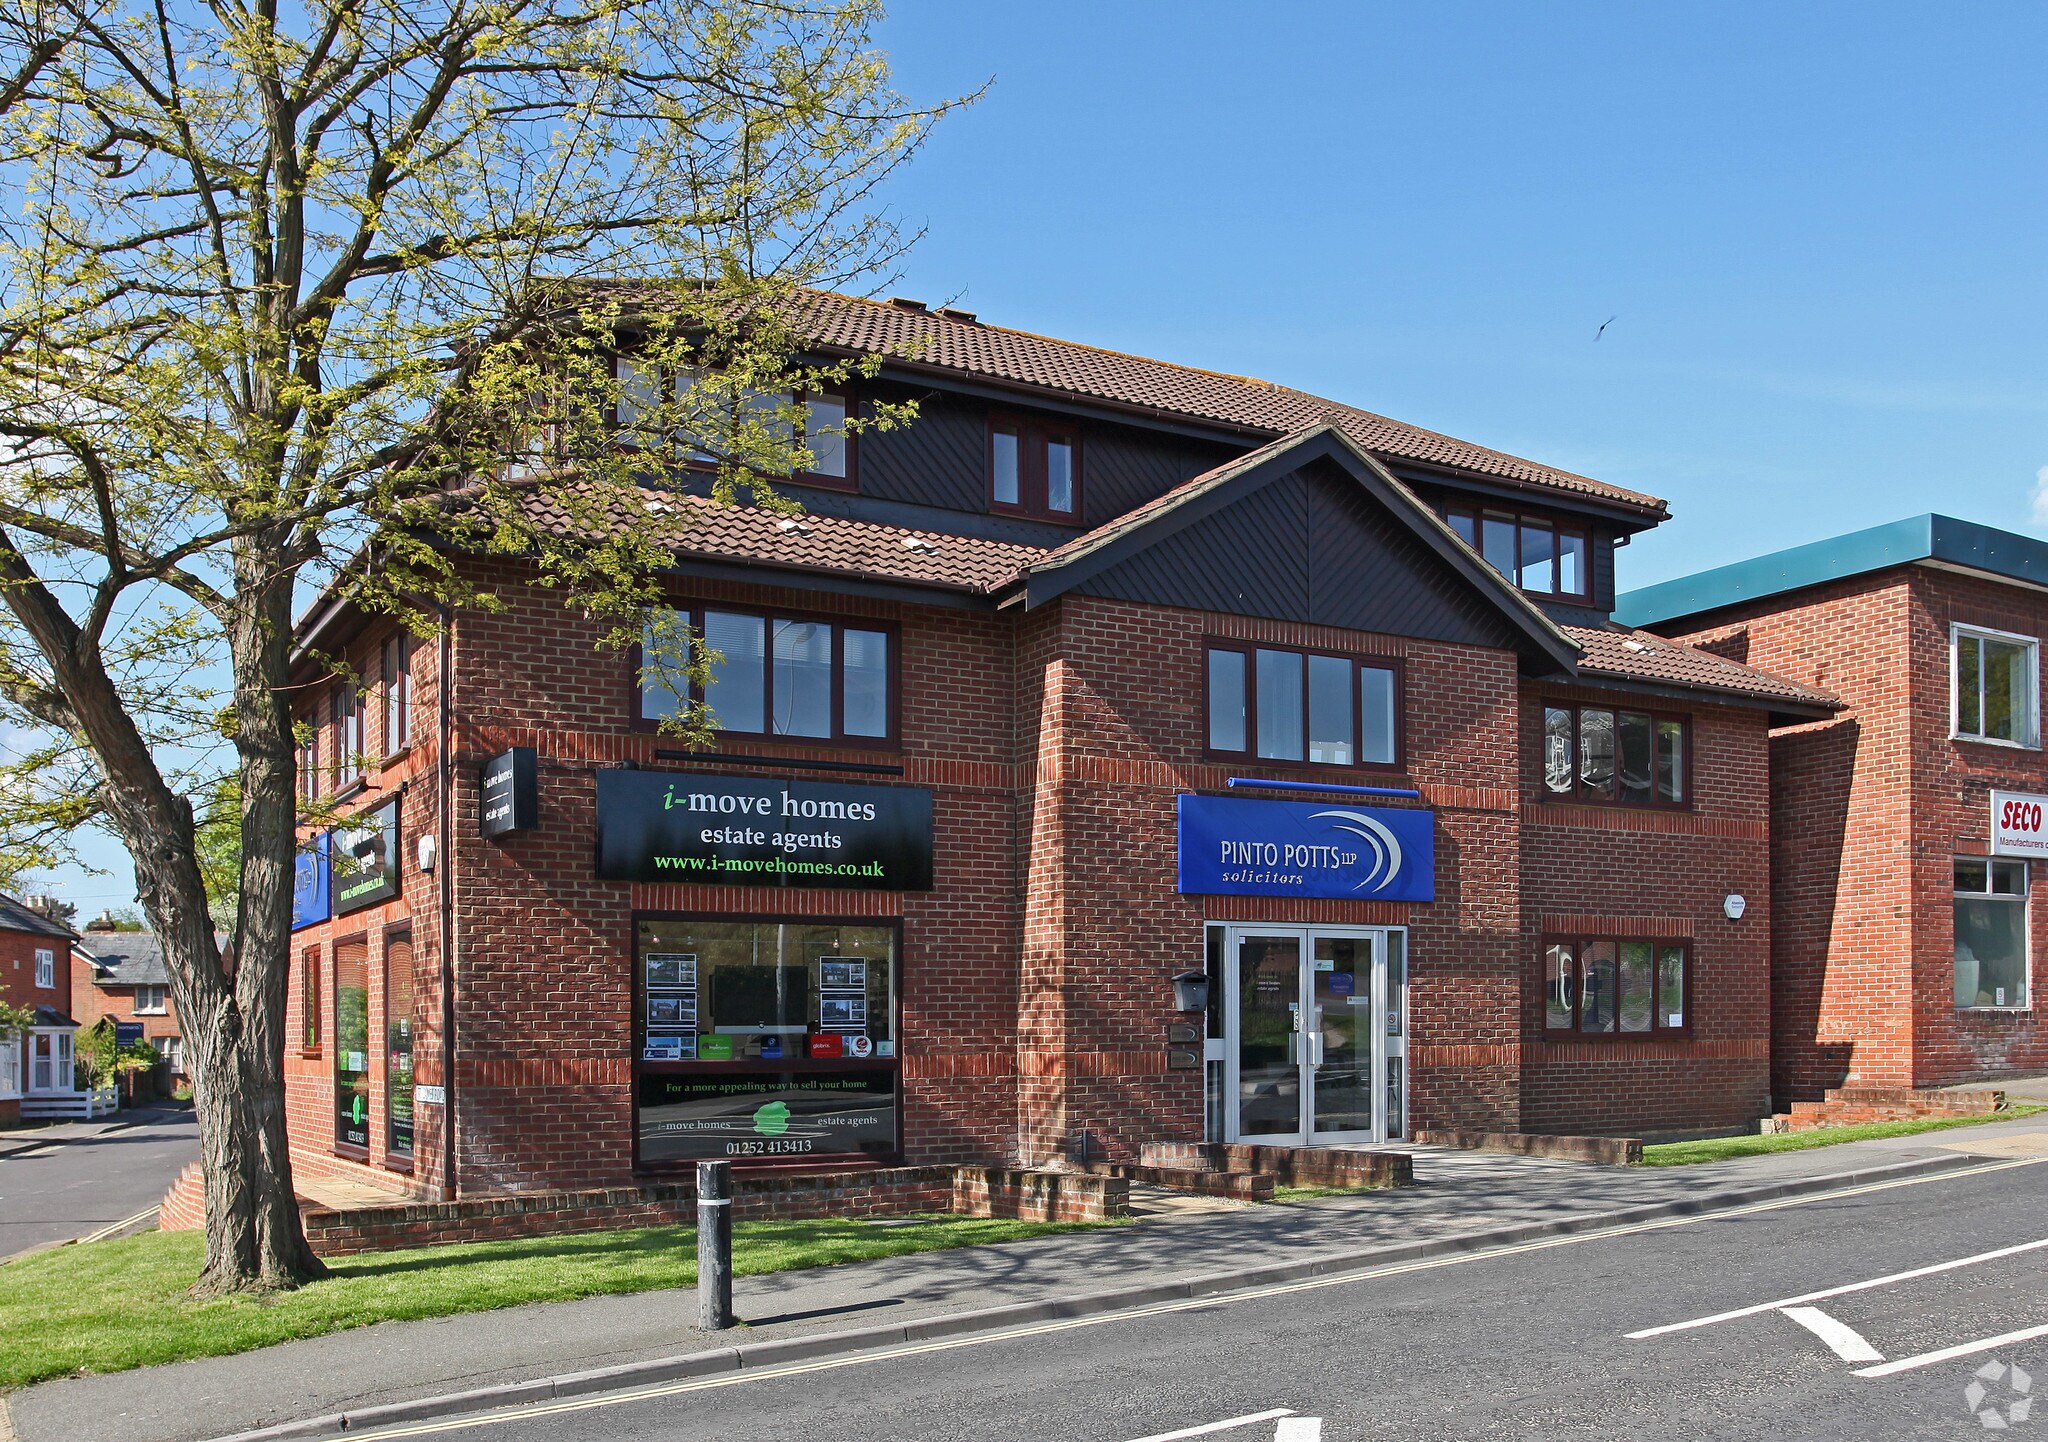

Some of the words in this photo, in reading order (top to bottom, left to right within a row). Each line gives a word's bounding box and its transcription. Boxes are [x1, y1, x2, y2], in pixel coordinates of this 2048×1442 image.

[663, 784, 772, 817] i-move
[780, 790, 877, 821] homes
[2001, 801, 2042, 832] SECO
[700, 825, 765, 846] estate
[771, 829, 842, 853] agents
[2000, 837, 2044, 849] Manufacturers
[1220, 840, 1278, 867] PINTO
[1284, 843, 1340, 869] POTTS
[653, 854, 885, 877] www.i-movehomes.co.uk
[1222, 868, 1303, 886] solicitors
[666, 1083, 682, 1092] For
[692, 1084, 717, 1092] more
[719, 1081, 767, 1095] appealing
[768, 1083, 787, 1094] way
[789, 1082, 799, 1091] to
[801, 1080, 817, 1090] sell
[819, 1082, 841, 1093] your
[842, 1079, 868, 1090] home
[697, 1119, 731, 1130] homes
[817, 1116, 845, 1126] estate
[847, 1115, 879, 1128] agents
[726, 1141, 765, 1156] 01252
[767, 1140, 813, 1155] 413413
